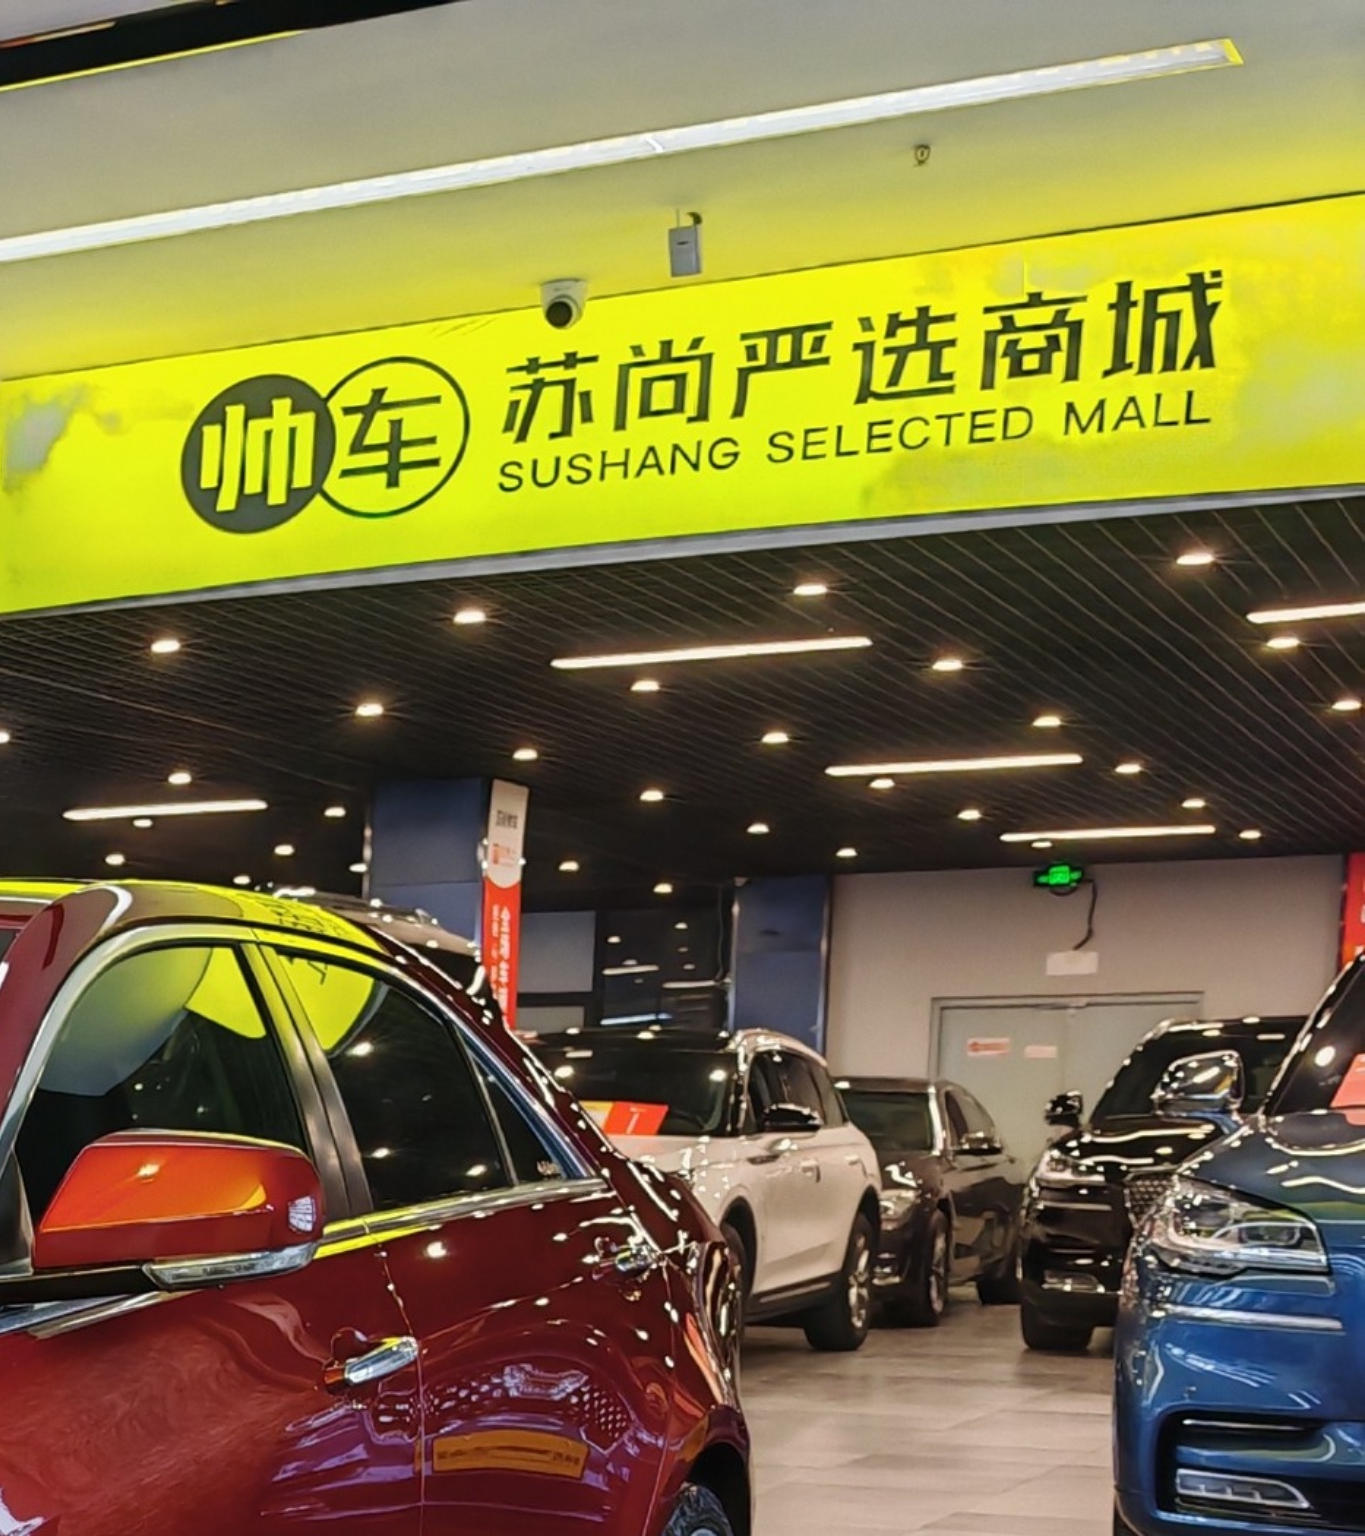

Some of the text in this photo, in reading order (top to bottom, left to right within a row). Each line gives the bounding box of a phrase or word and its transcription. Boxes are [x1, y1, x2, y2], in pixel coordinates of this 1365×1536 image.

[502, 269, 1223, 444] 苏尚严选商城
[498, 389, 1213, 493] SUSHANG SELECTED MALL
